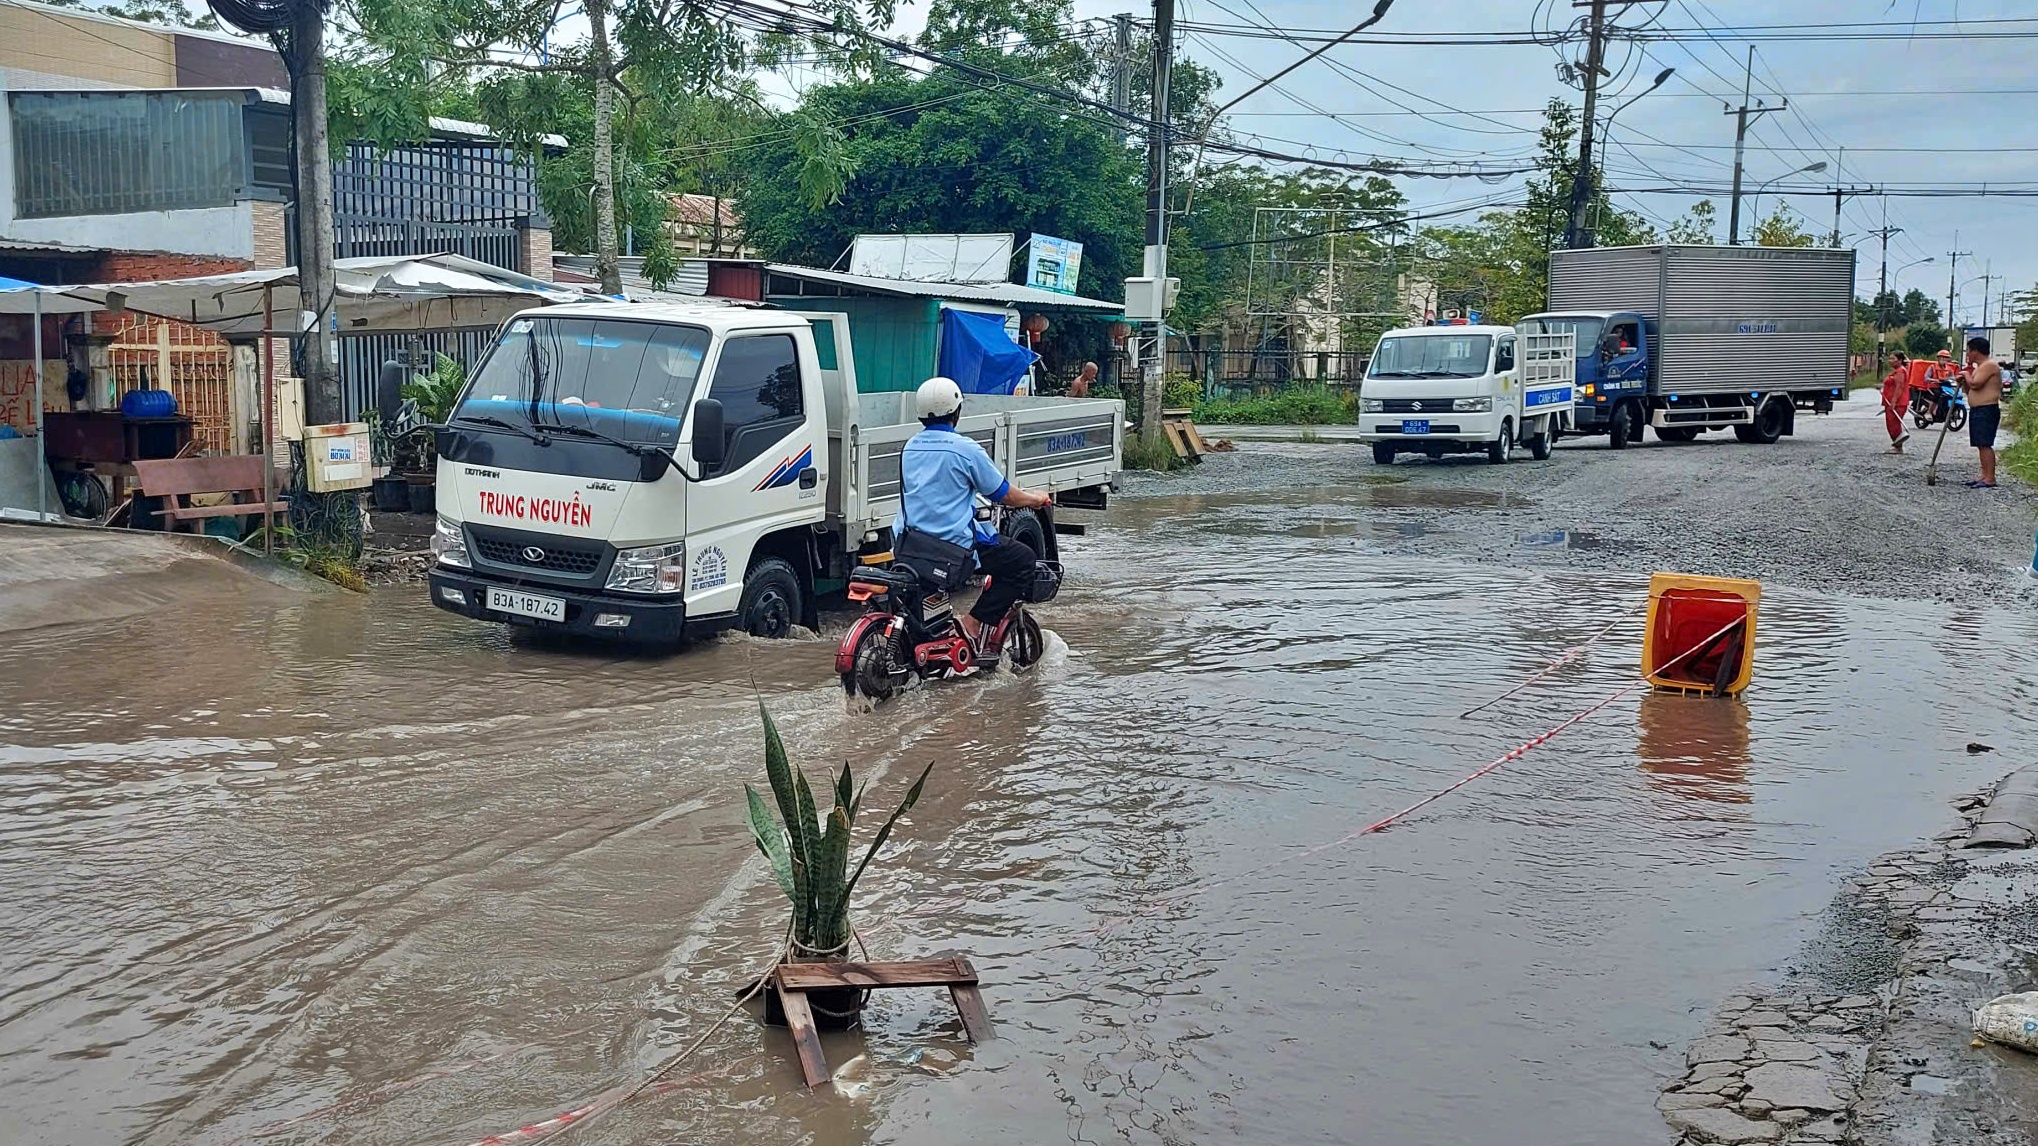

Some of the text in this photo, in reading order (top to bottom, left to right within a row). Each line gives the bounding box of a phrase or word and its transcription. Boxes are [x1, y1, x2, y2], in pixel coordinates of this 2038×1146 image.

[586, 481, 617, 492] JMC
[480, 491, 525, 518] TRUNG
[493, 592, 558, 617] 83A-187.42
